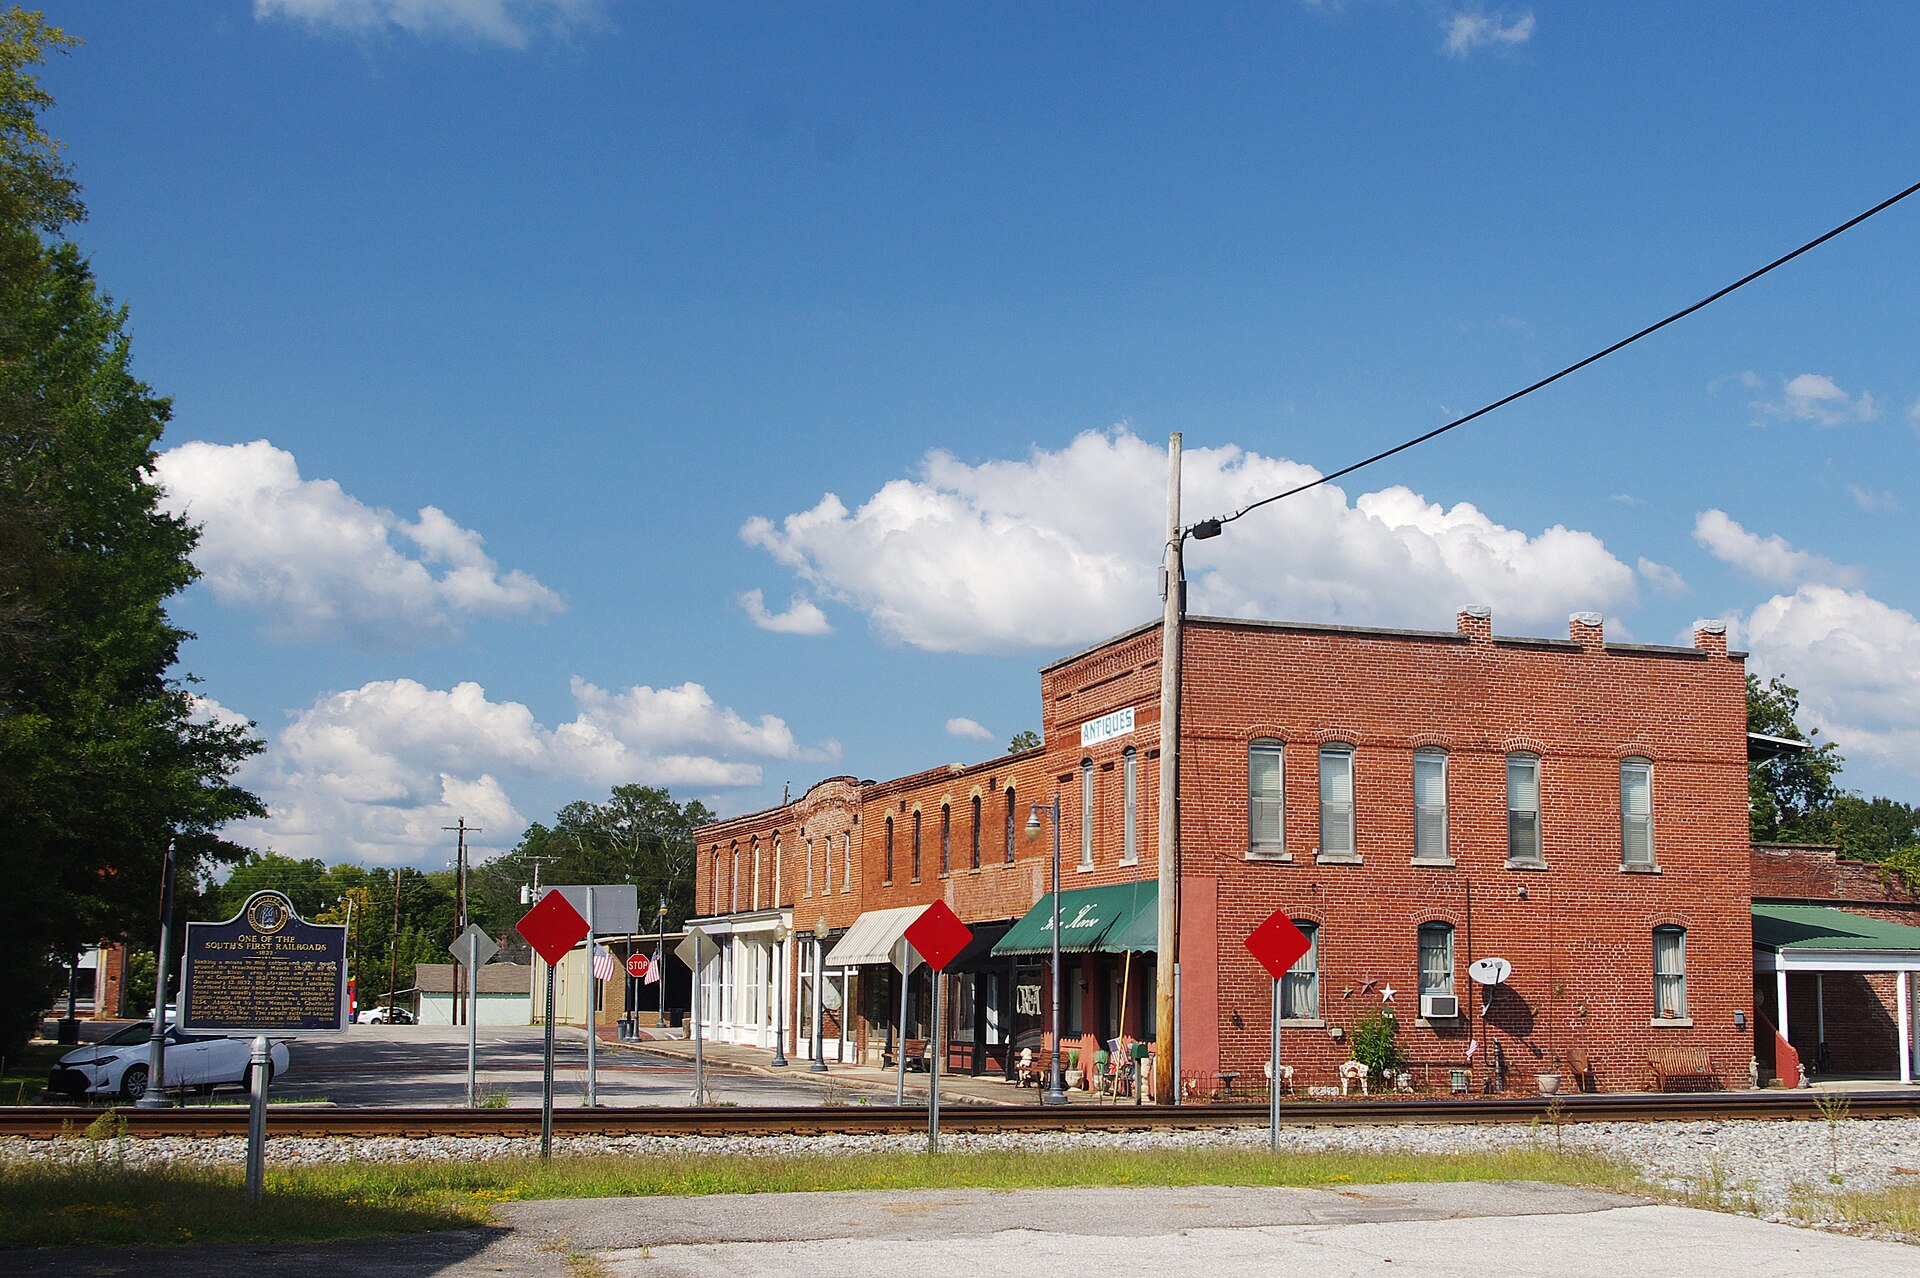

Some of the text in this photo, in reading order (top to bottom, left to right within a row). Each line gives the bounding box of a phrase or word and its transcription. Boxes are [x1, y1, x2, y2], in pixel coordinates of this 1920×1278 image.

[1083, 709, 1132, 742] ANTIQUES
[238, 934, 258, 942] ONE
[205, 942, 243, 950] SOUTH'S
[628, 960, 648, 970] STOP
